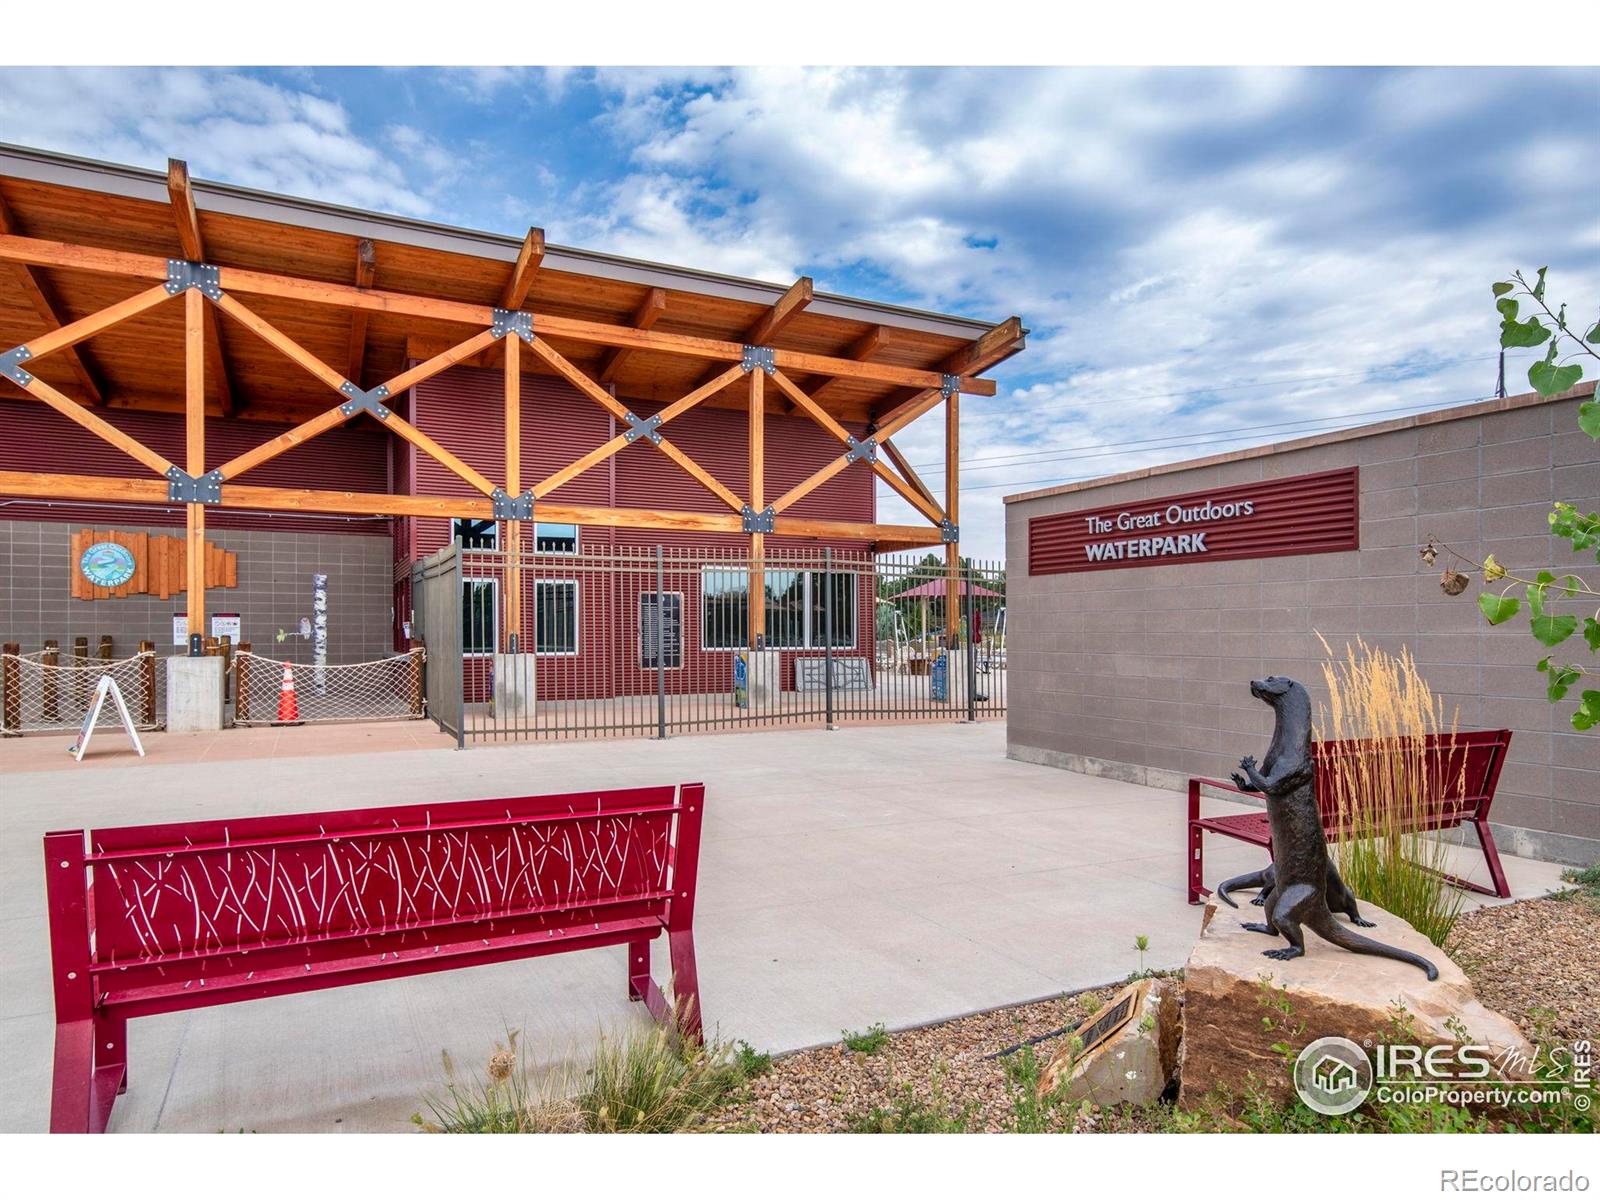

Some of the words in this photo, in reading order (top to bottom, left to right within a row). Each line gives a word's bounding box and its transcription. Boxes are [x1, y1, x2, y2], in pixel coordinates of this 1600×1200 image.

[1085, 517, 1112, 534] The
[1117, 512, 1161, 531] Great
[1165, 500, 1254, 525] Outdoors
[1085, 532, 1208, 562] WATERPARK
